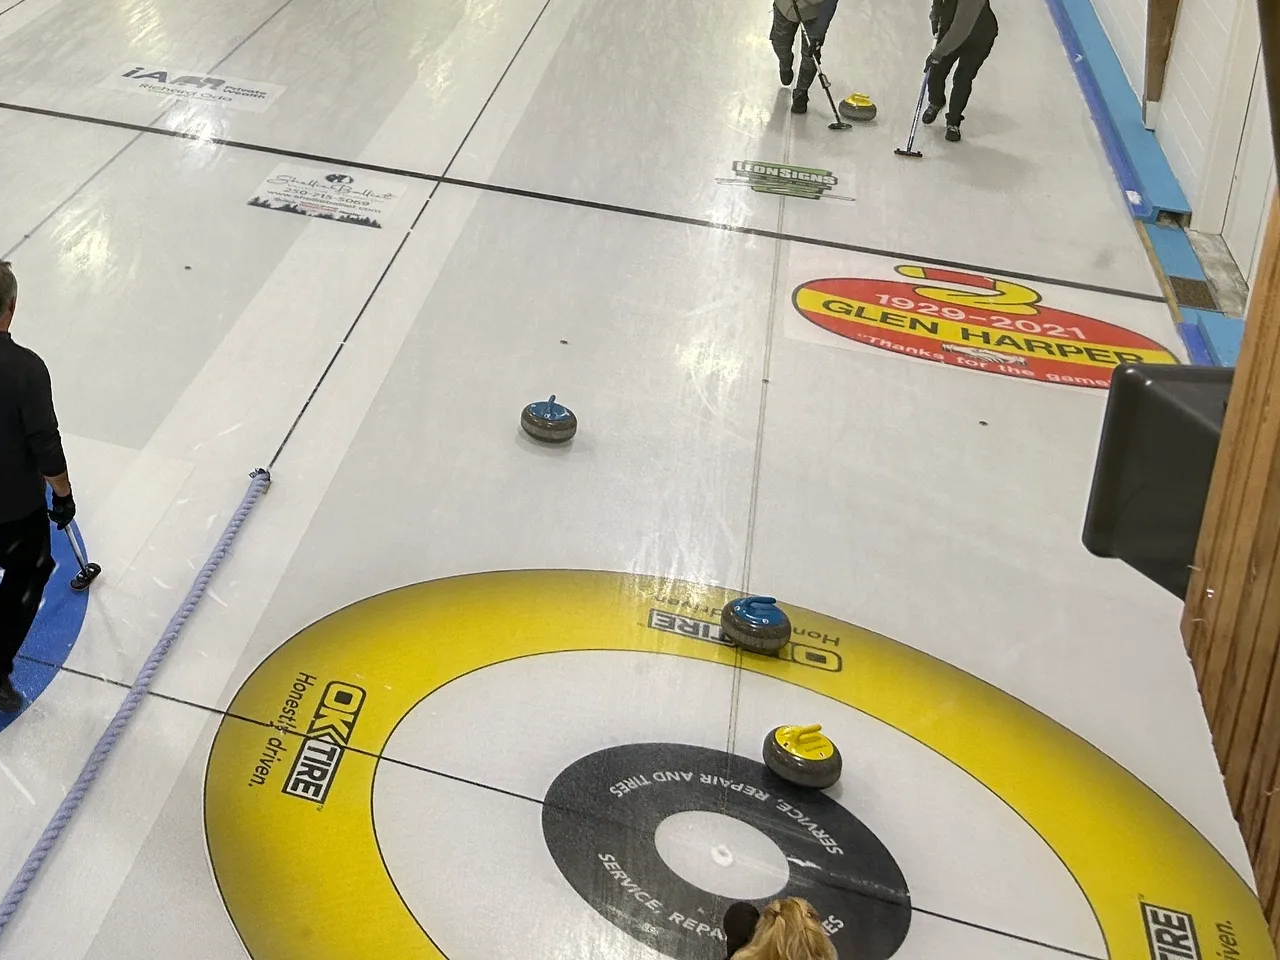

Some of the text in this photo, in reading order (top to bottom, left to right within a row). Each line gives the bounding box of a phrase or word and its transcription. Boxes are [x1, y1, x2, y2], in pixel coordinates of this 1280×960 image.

[821, 299, 1145, 365] GLEN HARPER
[876, 292, 1087, 340] 1929-2021
[955, 356, 988, 371] for
[998, 362, 1036, 379] the
[247, 737, 287, 788] driven.
[290, 682, 366, 799] OK TIRE
[609, 771, 844, 856] SERVICE, REPAIR AND TIRES
[598, 852, 728, 942] SERVICE, REPA
